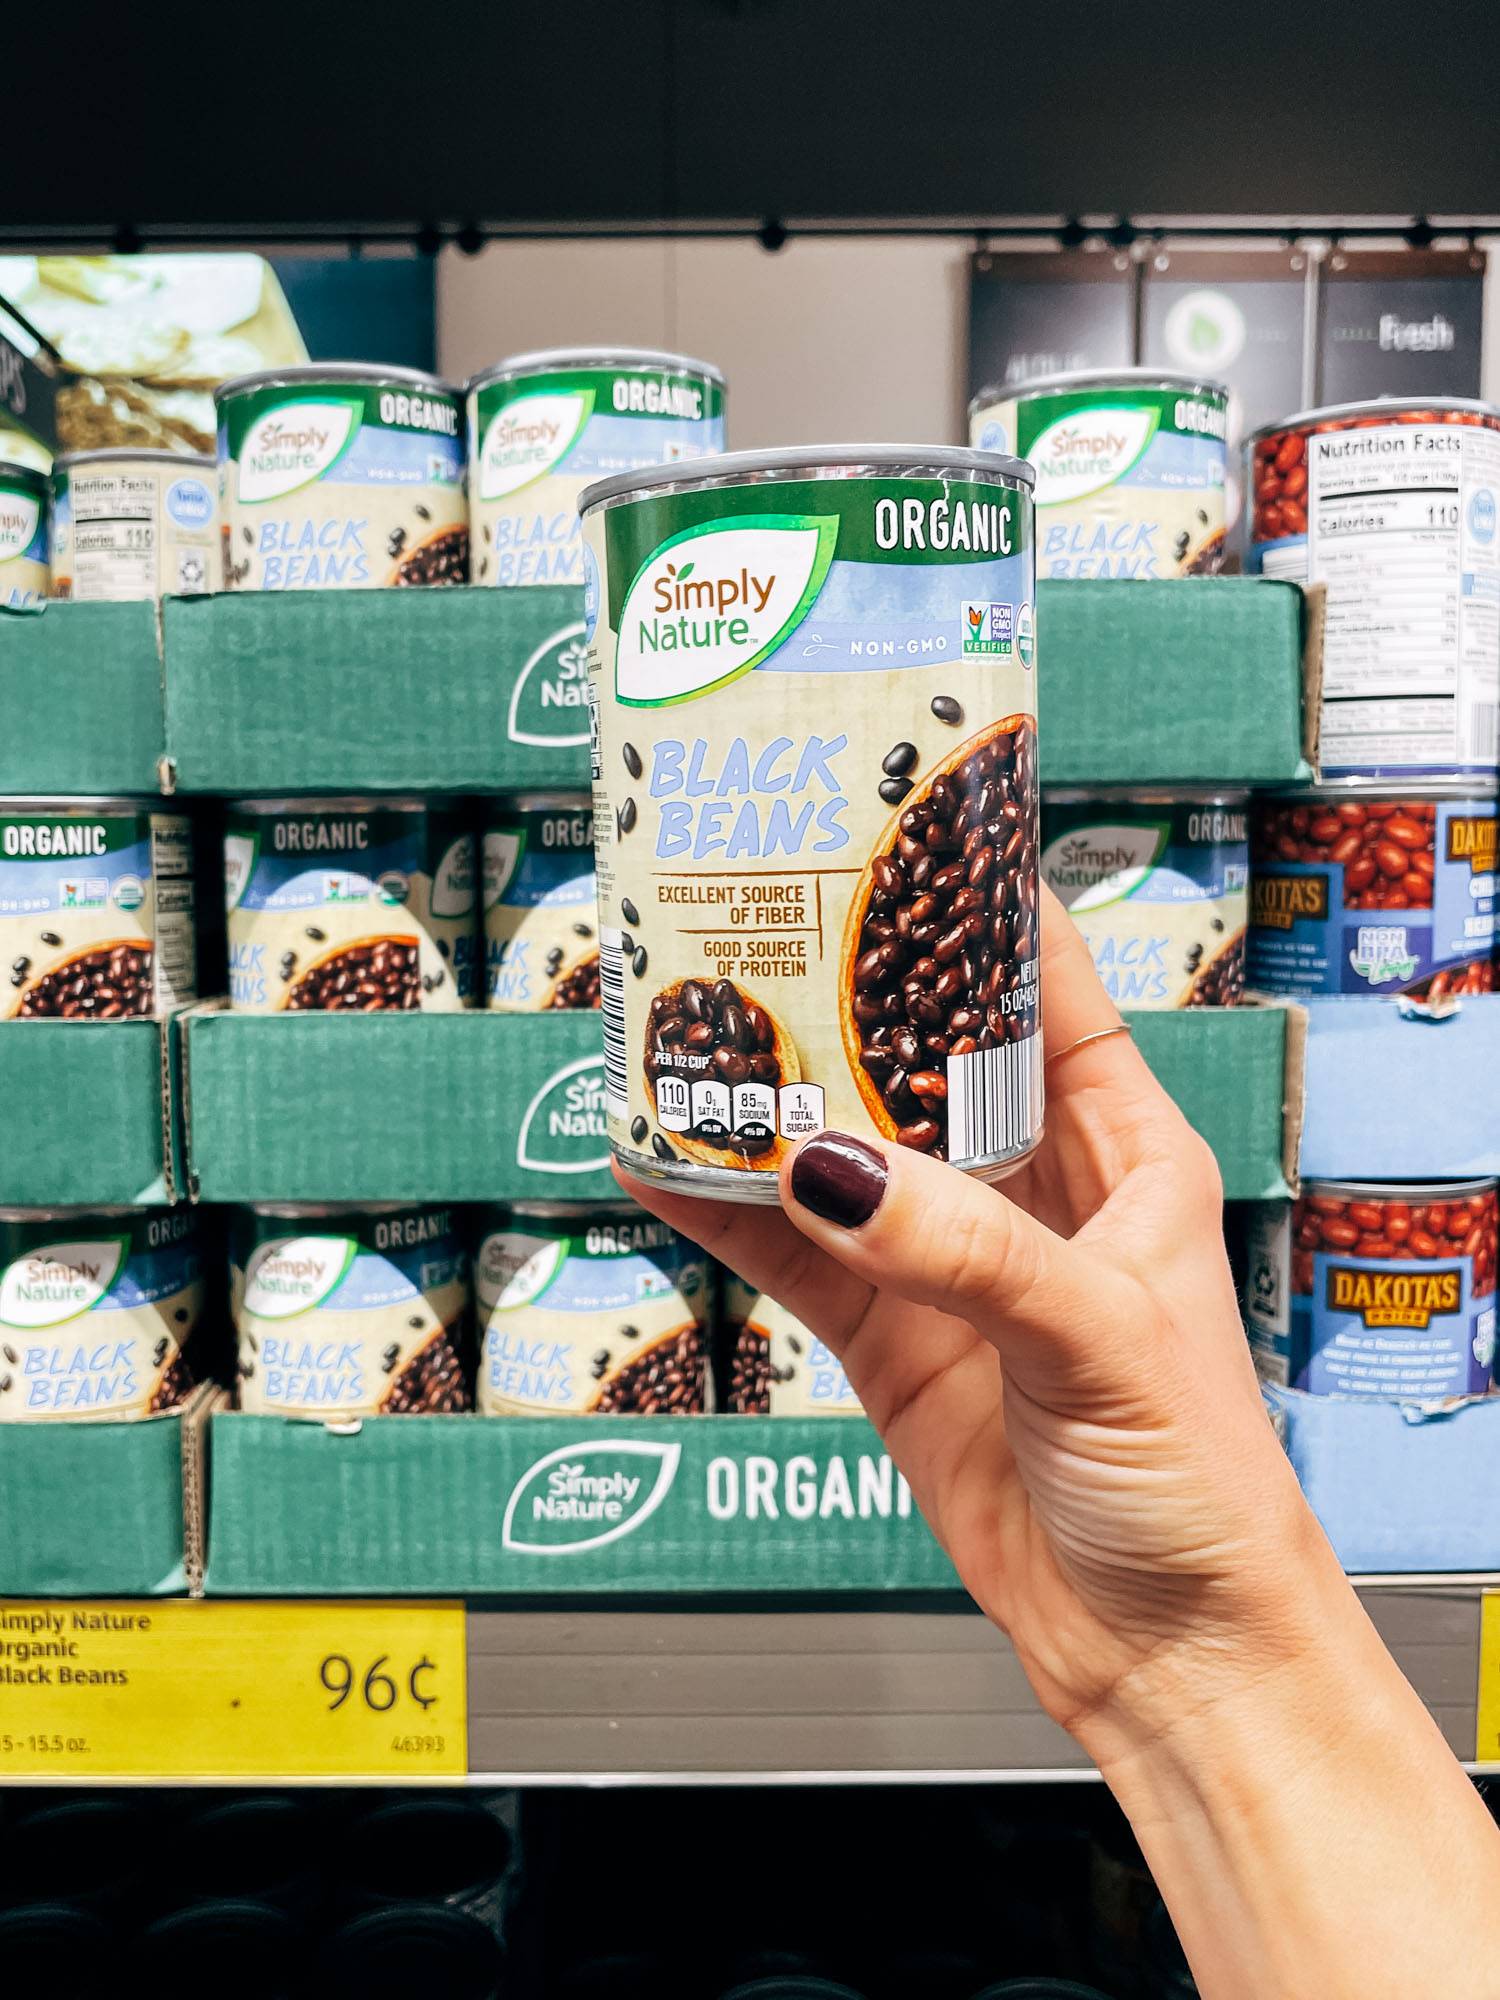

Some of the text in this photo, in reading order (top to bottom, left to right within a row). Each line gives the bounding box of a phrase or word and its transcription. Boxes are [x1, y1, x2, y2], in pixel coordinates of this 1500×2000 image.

[613, 378, 702, 421] ORGANIC
[379, 392, 458, 436] ORGANIC
[259, 425, 329, 453] Simply
[497, 417, 560, 447] Simply
[1050, 430, 1127, 458] Simply
[489, 445, 548, 468] Nature
[1317, 433, 1462, 461] Nutrition Facts
[249, 452, 317, 474] Nature
[1039, 455, 1113, 479] Nature
[874, 497, 1013, 555] ORGANIC
[1318, 516, 1385, 532] Calories
[1427, 504, 1460, 525] 110
[258, 518, 368, 554] BLACK
[1043, 519, 1158, 557] BLACK
[261, 552, 370, 590] BEANS
[497, 546, 580, 586] BEAN
[1049, 555, 1160, 579] BEANS
[653, 567, 776, 617] Simply
[991, 607, 1011, 619] NON
[991, 618, 1011, 631] GMO
[639, 615, 750, 655] Nature
[850, 635, 947, 656] NON-GMO
[966, 641, 1012, 653] VERIFIED
[649, 734, 848, 798] BLACK
[4, 824, 107, 856] ORGANIC
[274, 820, 369, 851] ORGANIC
[541, 818, 594, 847] ORGA
[655, 796, 850, 860] BEANS
[1060, 843, 1136, 869] Simply
[658, 885, 806, 904] EXCELLENT SOURCE
[730, 906, 806, 925] OF FIBER
[703, 940, 807, 958] GOOD SOURCE
[1096, 937, 1169, 967] ACK
[717, 960, 807, 977] OF PROTEIN
[1104, 970, 1169, 1000] ANS
[1000, 991, 1012, 1015] 15
[654, 1051, 709, 1070] PER 1/2 CUP
[661, 1082, 685, 1105] 110
[660, 1104, 688, 1118] CALORIES
[697, 1106, 725, 1118] SAT FAT
[739, 1109, 770, 1120] SODIUM
[789, 1110, 815, 1121] TOTAL
[28, 1259, 100, 1284] Simply
[262, 1257, 326, 1280] Simply
[16, 1282, 87, 1302] Nature
[255, 1277, 313, 1295] Nature
[1334, 1271, 1459, 1309] DAKOTA'S
[24, 1338, 136, 1376] BLACK
[261, 1337, 364, 1371] BLACK
[486, 1327, 574, 1371] BLACK
[28, 1370, 138, 1408] BEANS
[265, 1370, 364, 1402] BEANS
[489, 1358, 574, 1402] BEANS
[548, 1470, 641, 1503] Simply
[706, 1454, 912, 1521] ORGANI
[532, 1495, 624, 1522] Nature
[0, 1609, 152, 1634] imply Nature
[0, 1664, 129, 1686] lack Beans
[320, 1653, 438, 1712] 96¢
[28, 1734, 64, 1753] 15.5
[391, 1735, 446, 1753] 46393
